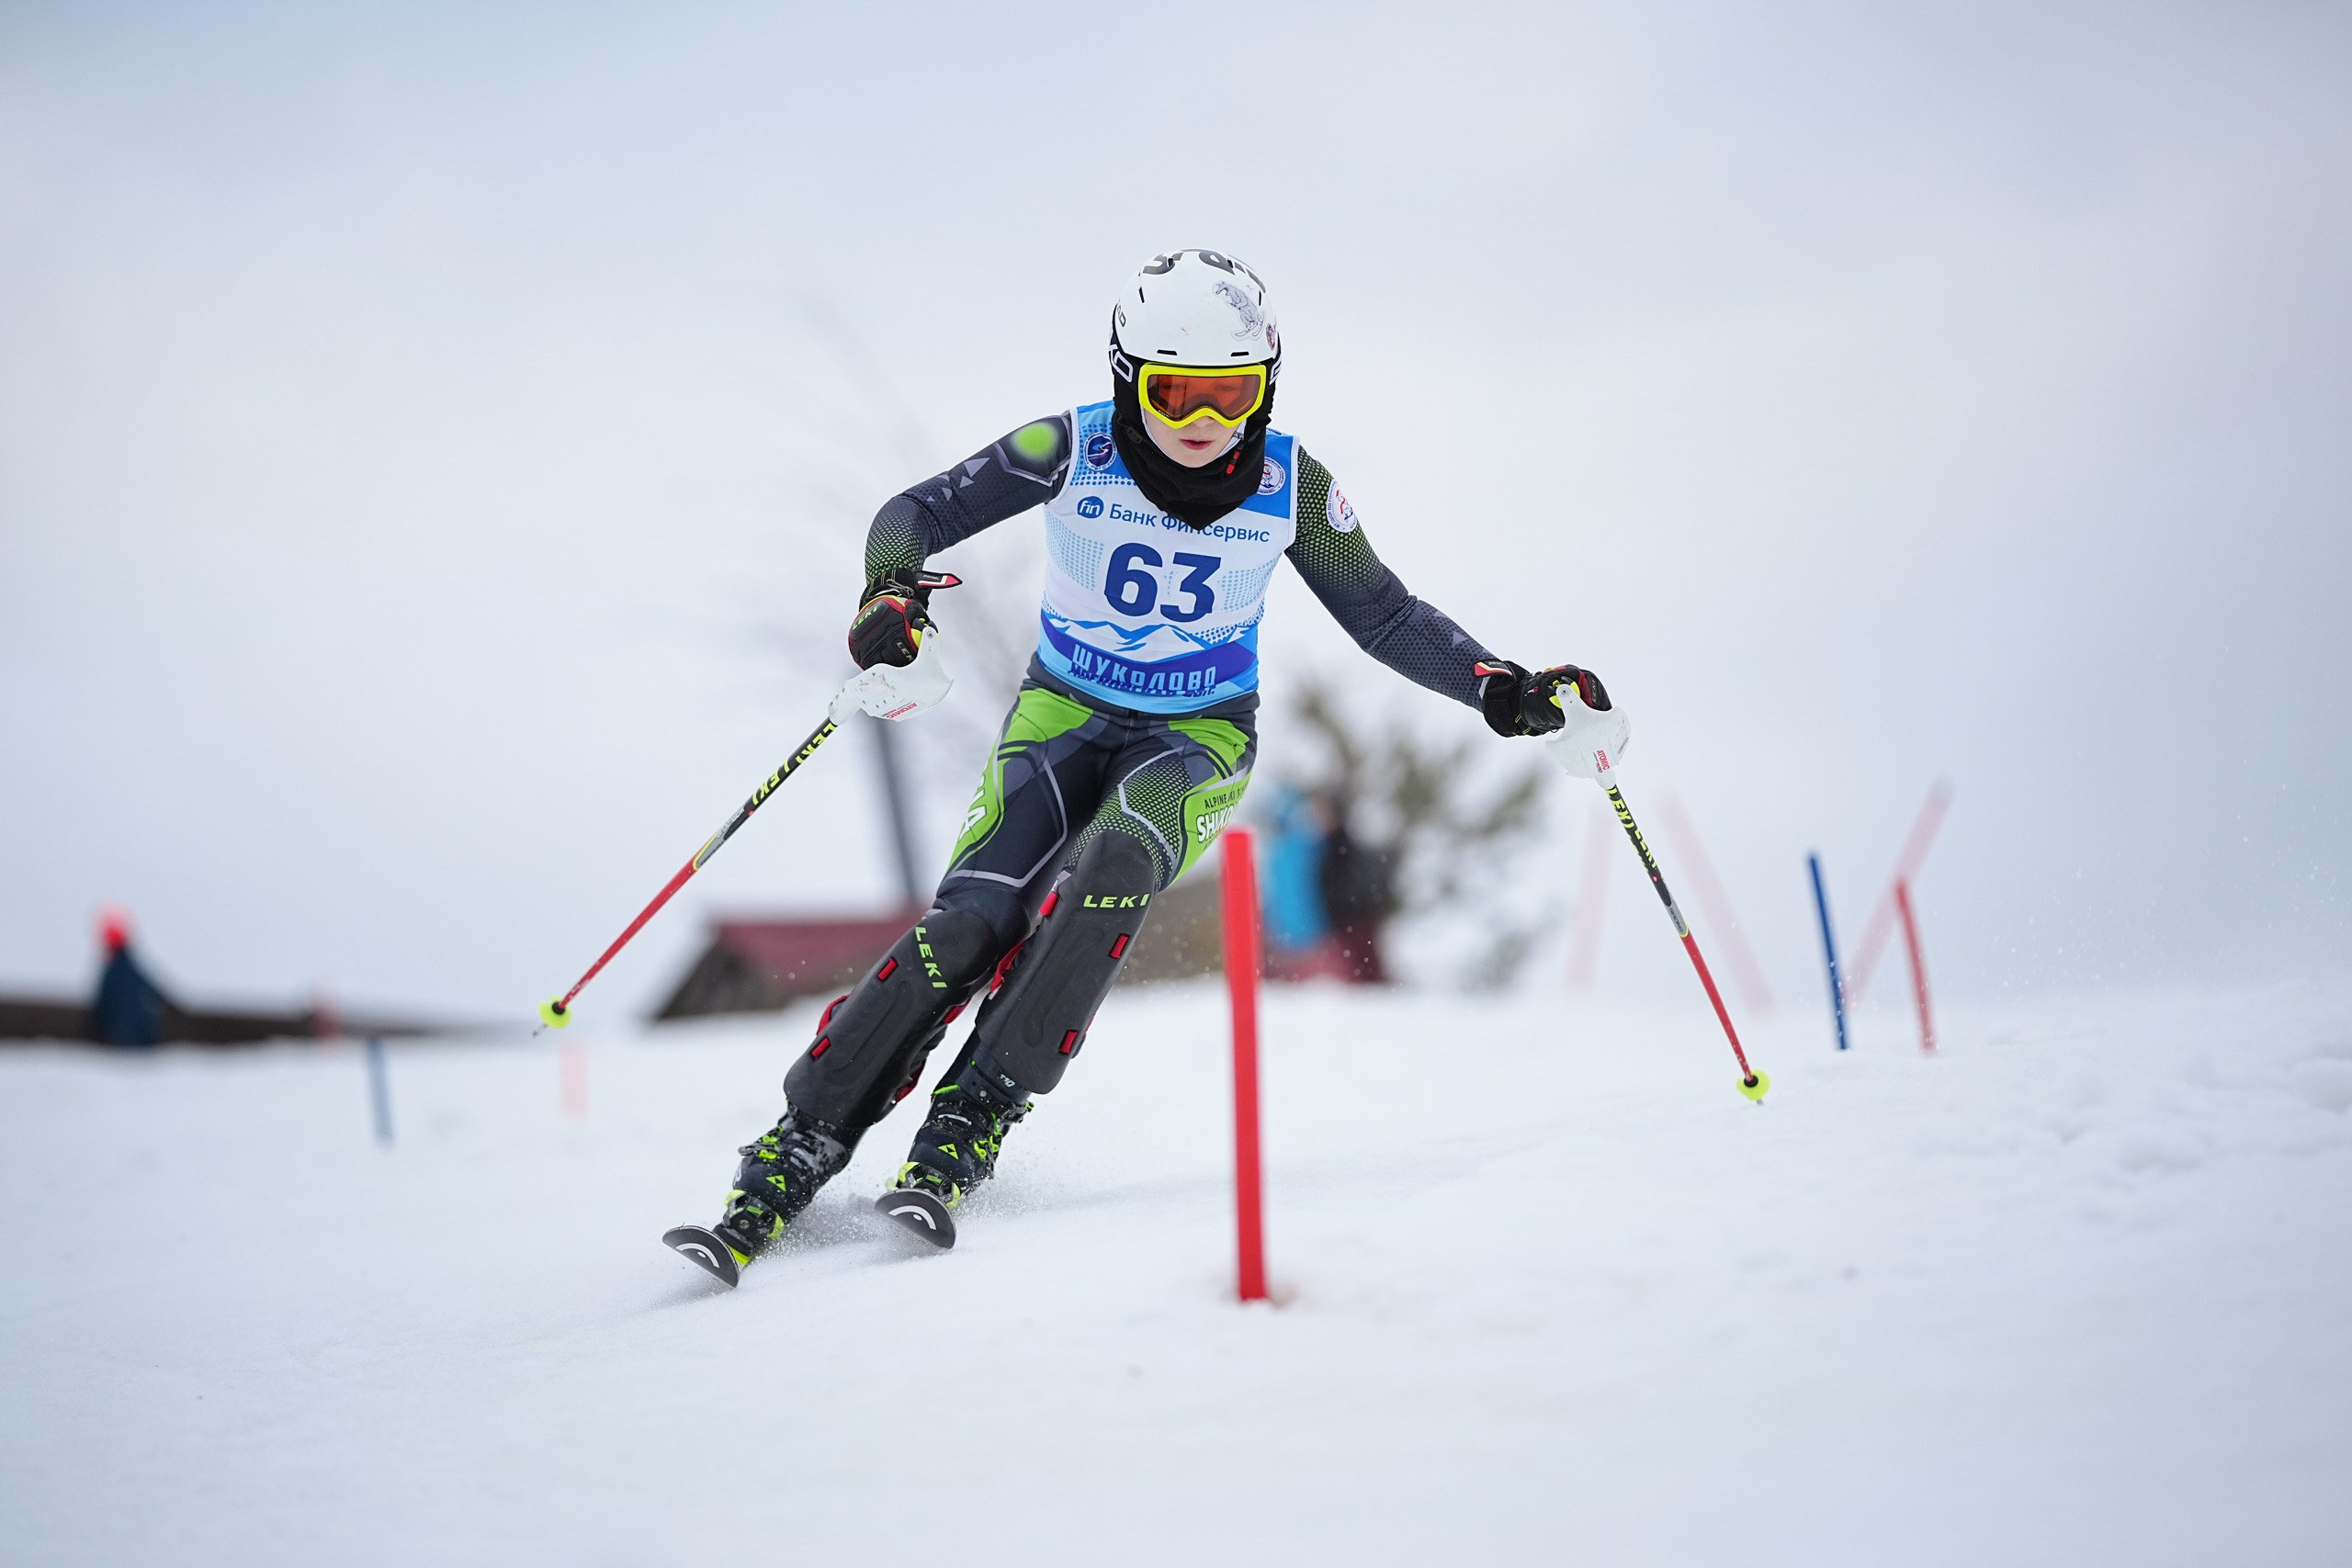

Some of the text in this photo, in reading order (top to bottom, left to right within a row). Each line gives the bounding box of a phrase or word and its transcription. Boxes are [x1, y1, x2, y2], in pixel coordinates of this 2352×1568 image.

[1080, 500, 1101, 516] fin
[1109, 502, 1270, 543] Банк Фисервис
[1103, 542, 1222, 623] 63
[853, 605, 878, 631] LEKI
[1071, 643, 1217, 691] ШУКОЛОВО
[1597, 750, 1610, 771] ATOMIC
[1204, 794, 1227, 810] ALPINE
[1606, 787, 1634, 829] LEKI
[1082, 893, 1150, 908] LEKI
[914, 926, 947, 988] LEKI
